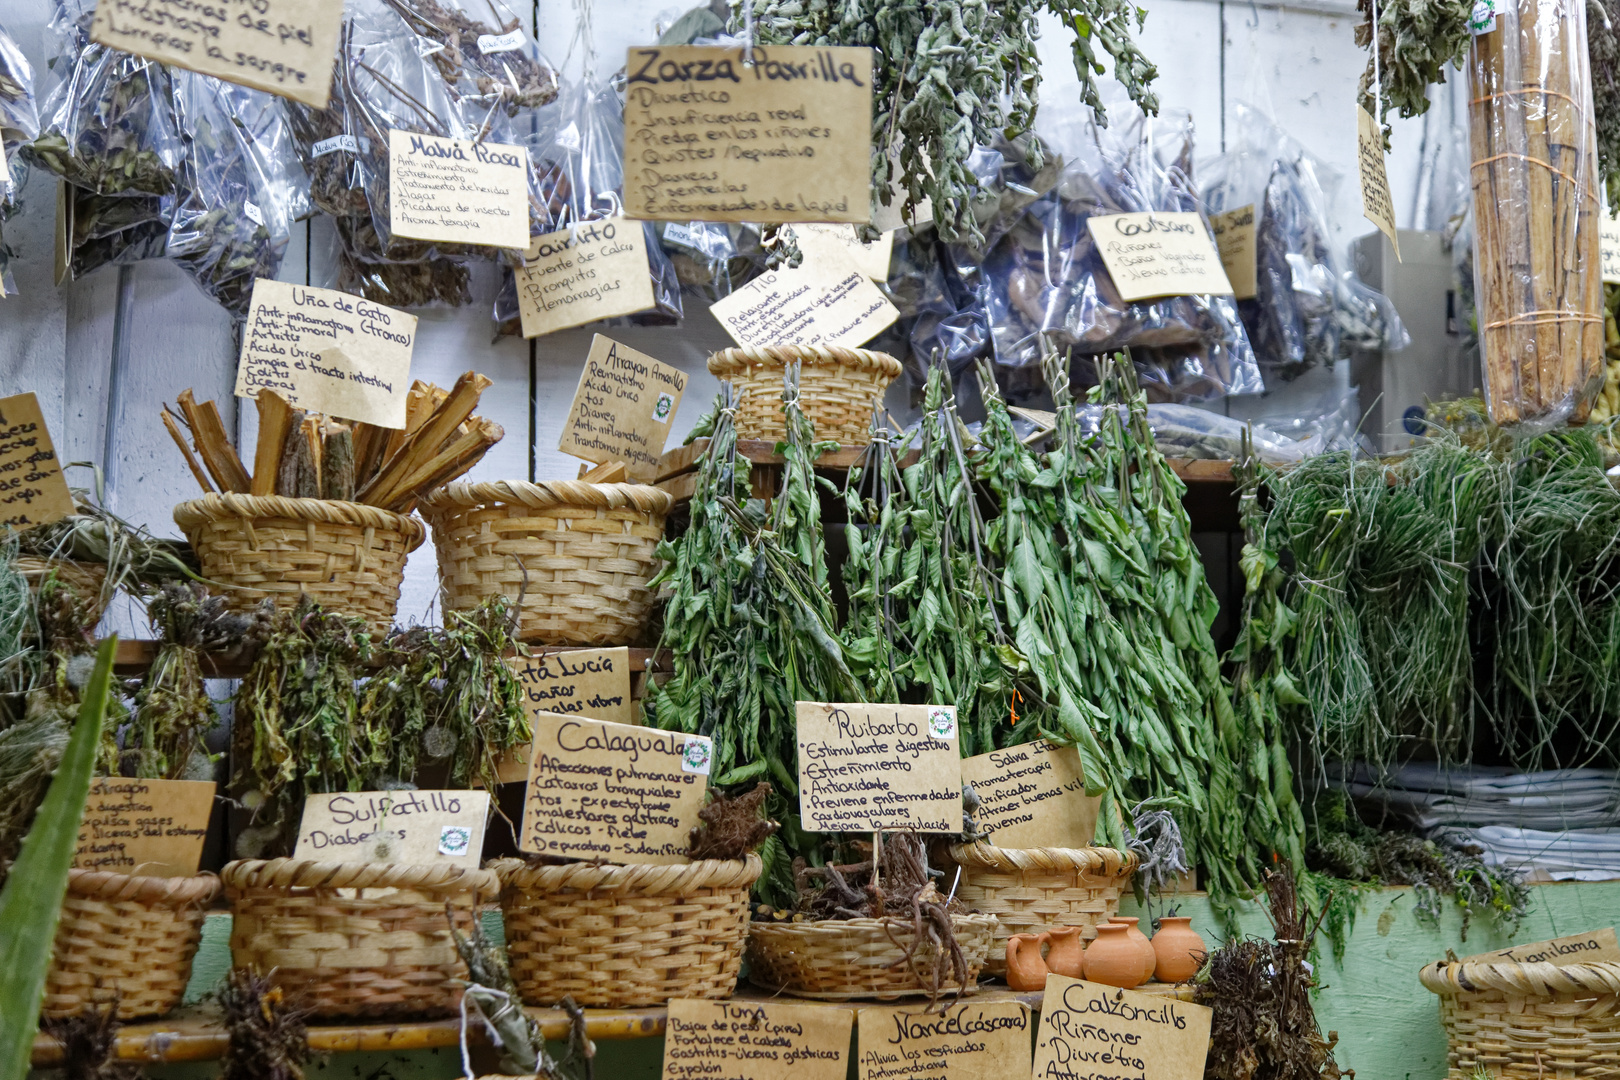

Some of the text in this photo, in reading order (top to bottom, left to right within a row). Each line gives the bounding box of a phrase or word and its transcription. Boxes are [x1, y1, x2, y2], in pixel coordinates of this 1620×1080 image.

[238, 14, 275, 37] de
[235, 52, 307, 83] sangre
[628, 50, 741, 84] Zarza
[706, 128, 731, 141] en
[471, 143, 521, 168] Rosa
[641, 147, 716, 165] Quistes
[401, 212, 436, 226] Aroma
[456, 202, 470, 213] de
[523, 257, 574, 281] Fuente
[577, 251, 598, 265] de
[525, 268, 597, 300] Bronquitis
[535, 279, 621, 313] Hemorragias
[743, 274, 777, 295] Tilo
[292, 287, 391, 326] Uña de Gato
[727, 291, 782, 328] Relajante
[360, 319, 412, 348] (tronco)
[247, 353, 289, 369] Limpia
[294, 359, 307, 371] el
[309, 361, 345, 380] tracto
[589, 361, 645, 391] Reumatismo
[580, 403, 616, 423] Diarrea
[528, 685, 576, 702] baños
[828, 709, 918, 739] Ruibarbo
[557, 721, 687, 762] Calaguala
[806, 734, 950, 759] Estimulante digestivo
[540, 753, 697, 784] Afecciones pulmonares
[806, 756, 912, 780] Estreñimiento
[989, 752, 1030, 769] Salvia
[811, 777, 890, 795] Antioxidante
[970, 761, 1052, 790] Aromaterapia
[535, 776, 682, 800] Catarros bronquiales
[810, 787, 960, 810] Previene enfermedades
[978, 782, 1037, 805] urificador
[328, 792, 461, 825] Sulfatillo
[811, 802, 910, 822] cardiovasculares
[978, 786, 1063, 820] Atraer buenas
[80, 816, 174, 831] xpulsar gases
[535, 807, 618, 825] malestares
[982, 813, 1034, 835] Quemar
[532, 836, 611, 853] Depurativo
[669, 1017, 708, 1035] Bajar
[711, 1019, 728, 1031] de
[731, 1019, 760, 1033] peso
[1050, 1010, 1142, 1046] Riñones
[673, 1032, 735, 1046] Fortalece
[738, 1033, 751, 1044] el
[865, 1040, 987, 1067] Alivia los resfriados
[1050, 1036, 1145, 1071] Diurético
